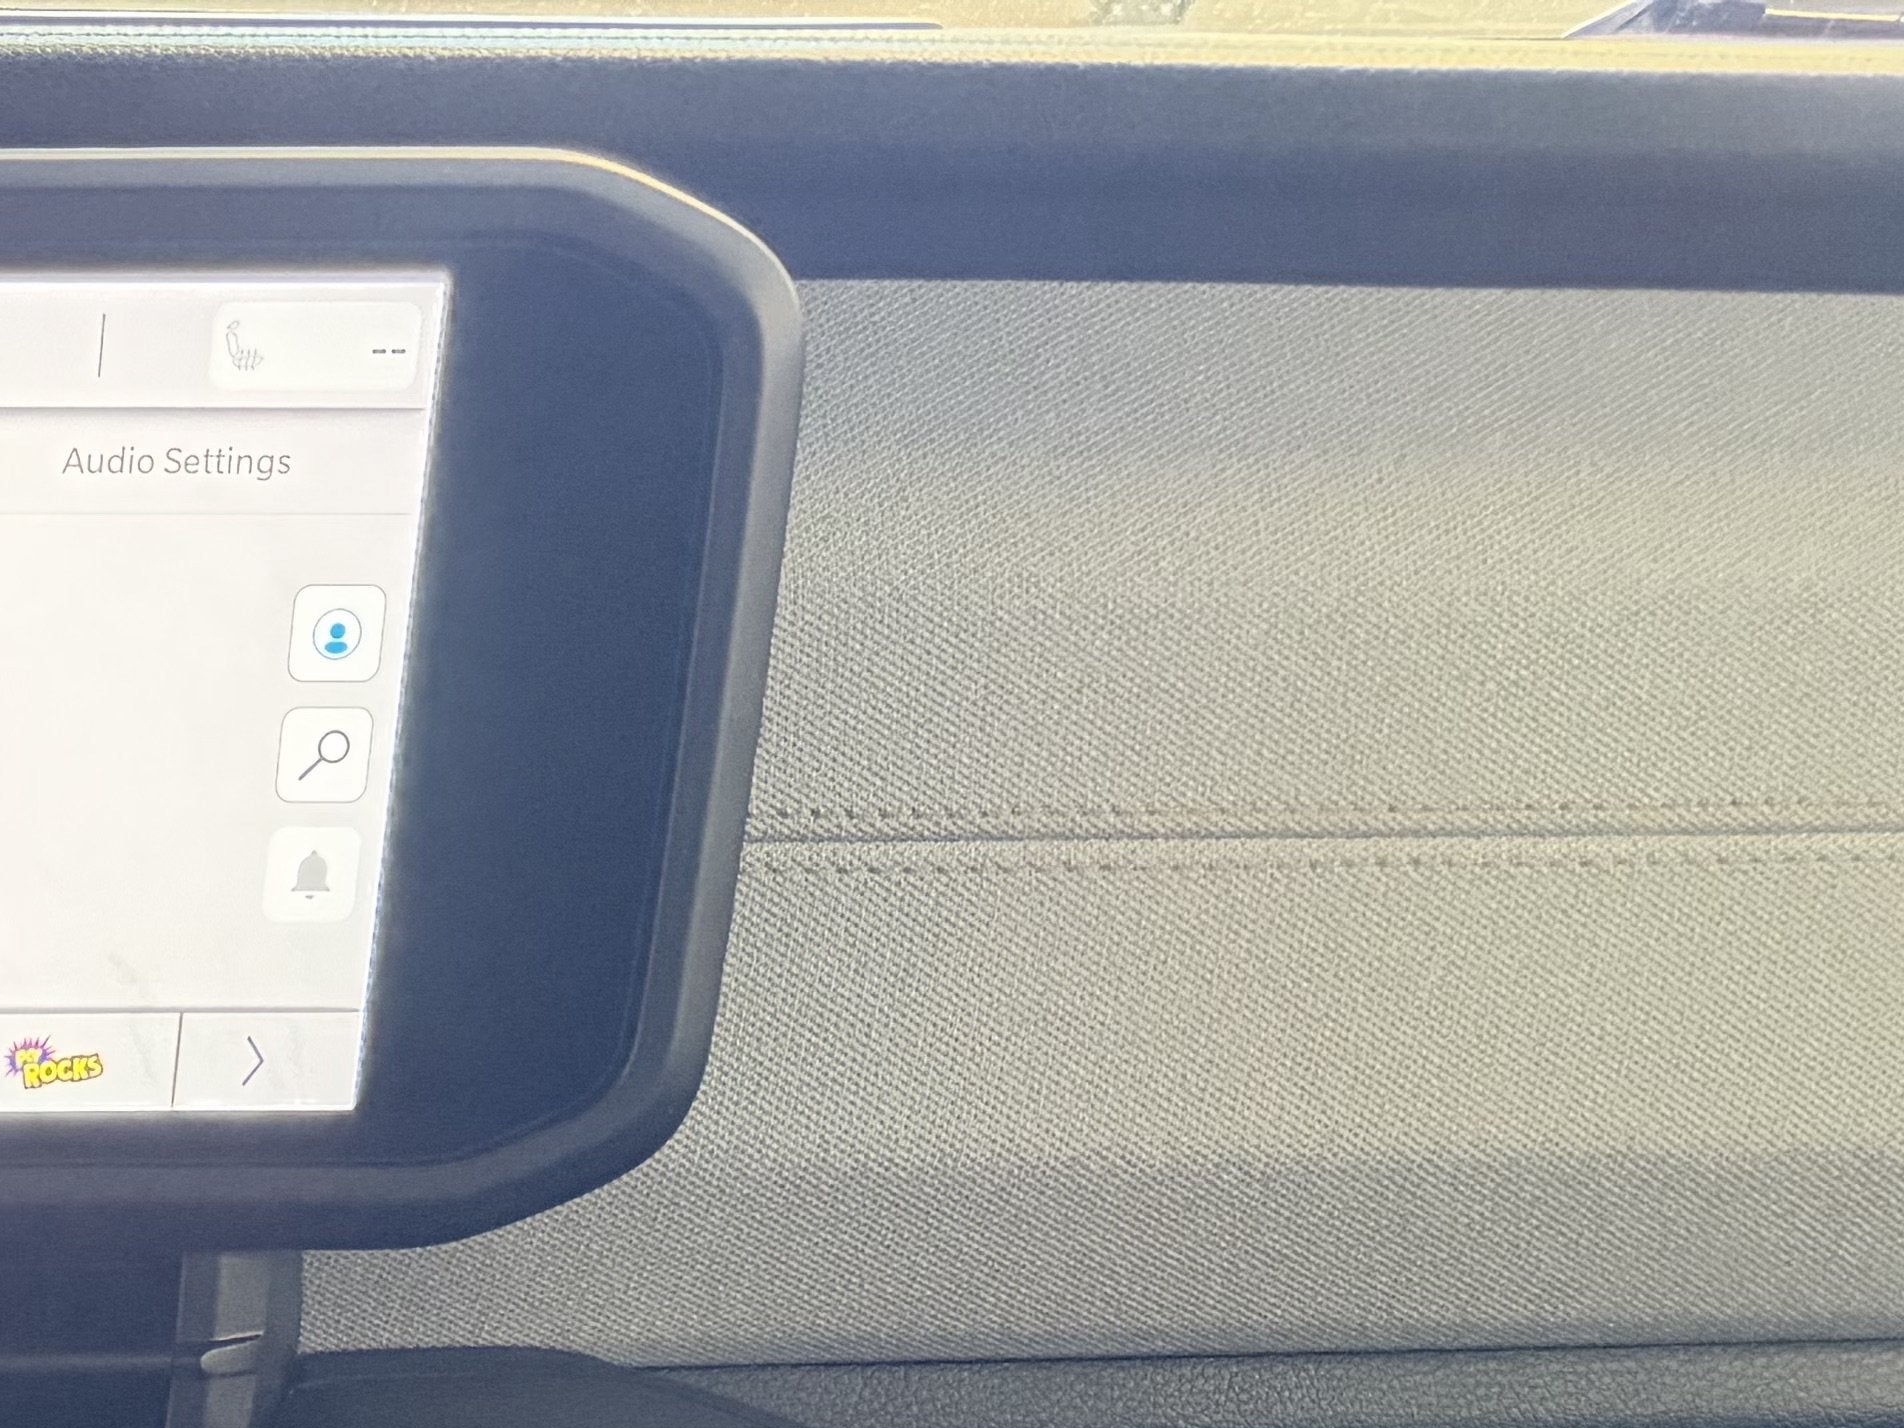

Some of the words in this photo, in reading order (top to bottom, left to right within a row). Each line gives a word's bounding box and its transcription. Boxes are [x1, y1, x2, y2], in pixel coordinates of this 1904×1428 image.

[62, 445, 155, 477] Audio
[163, 446, 292, 482] Settings
[23, 1053, 104, 1089] ROCKS
